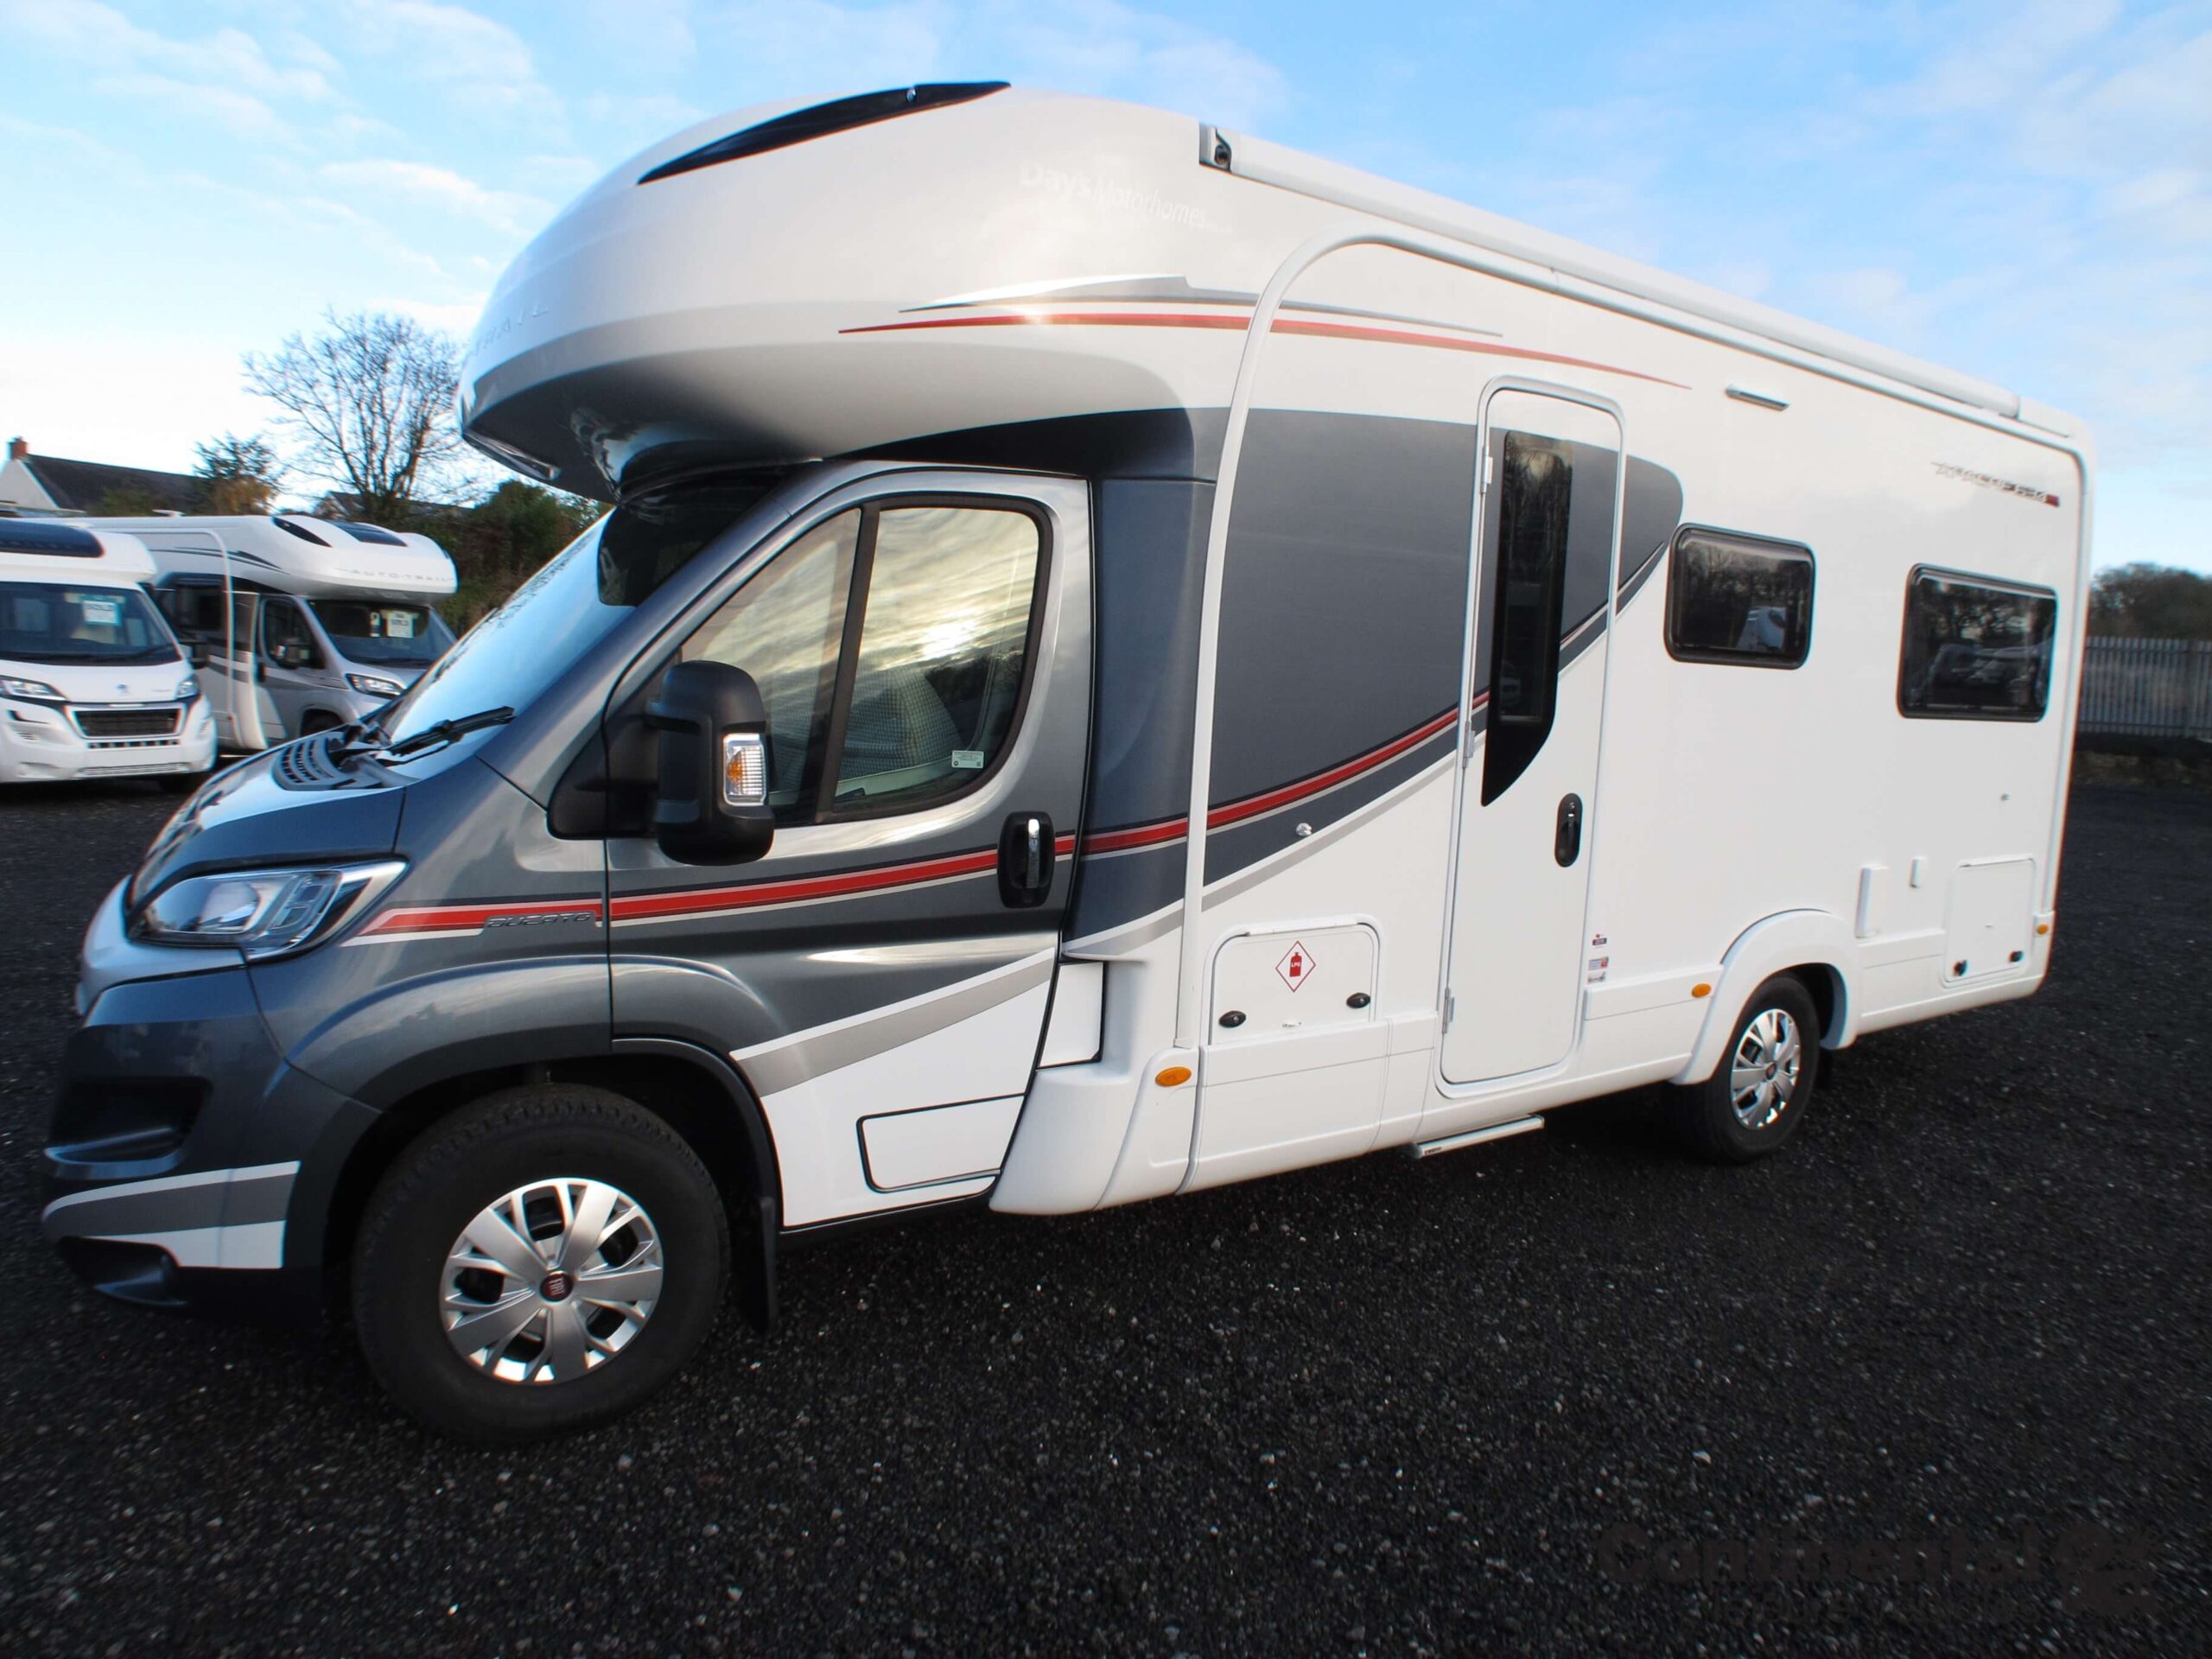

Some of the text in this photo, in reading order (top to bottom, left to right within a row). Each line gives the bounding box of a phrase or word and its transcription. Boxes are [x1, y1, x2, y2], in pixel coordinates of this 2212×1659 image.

[1021, 162, 1206, 228] Days Motorhomes
[486, 911, 593, 928] DUCATO
